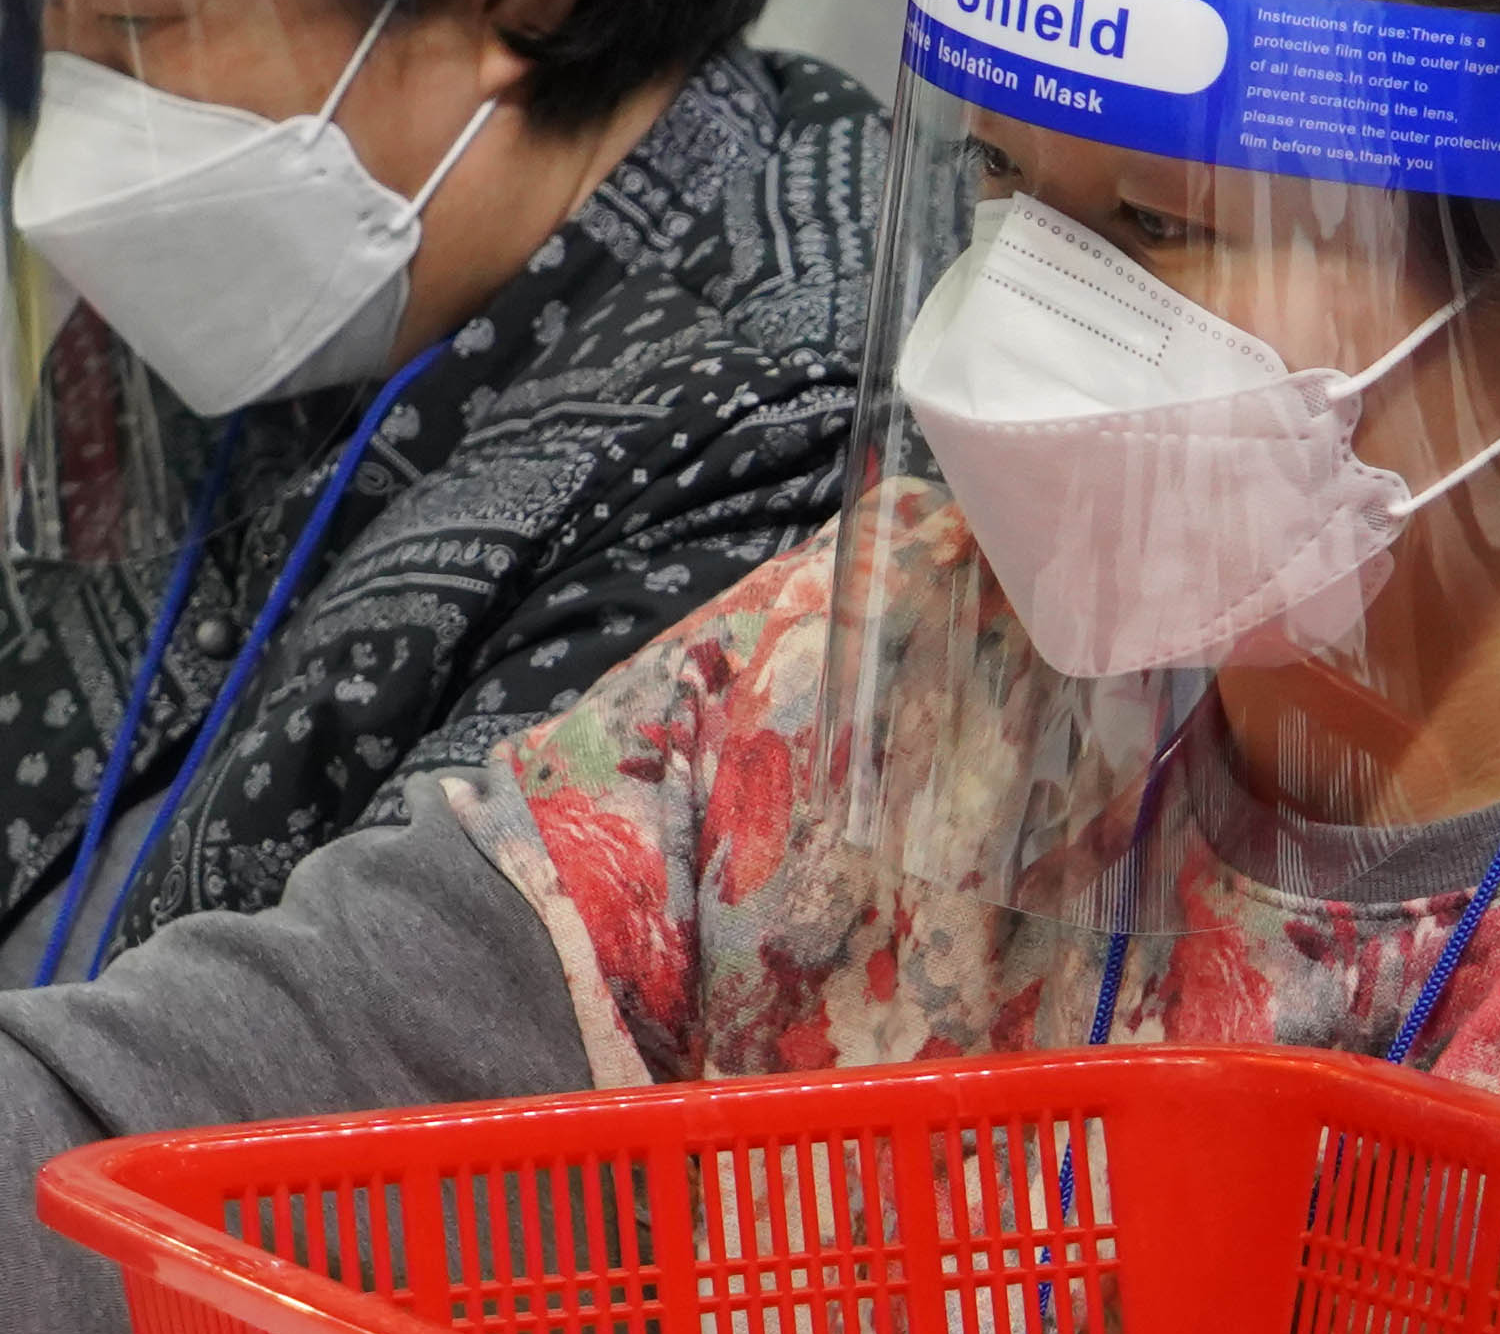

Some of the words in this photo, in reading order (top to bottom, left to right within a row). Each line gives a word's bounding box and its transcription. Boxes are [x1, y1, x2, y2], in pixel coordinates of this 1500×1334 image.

[1257, 8, 1348, 33] Instructions
[1353, 20, 1374, 35] for
[1460, 33, 1472, 47] is
[1476, 37, 1486, 48] a
[1253, 35, 1330, 55] protective
[1335, 44, 1362, 60] film
[1367, 50, 1387, 63] on
[1392, 51, 1416, 66] the
[1420, 56, 1460, 71] outer
[1464, 58, 1500, 76] layer
[938, 36, 1019, 91] Isolation
[1034, 74, 1104, 115] Mask
[1250, 59, 1267, 72] of
[1270, 62, 1289, 75] all
[1368, 75, 1410, 91] order
[1414, 79, 1429, 93] to
[1246, 85, 1306, 104] prevent
[1309, 94, 1389, 116] scratching
[1394, 102, 1418, 117] the
[1423, 106, 1459, 124] lens,
[1242, 109, 1295, 127] please
[1299, 118, 1357, 136] remove
[1361, 123, 1386, 139] the
[1390, 130, 1430, 145] outer
[1239, 132, 1267, 148] film
[1271, 136, 1322, 156] before
[1406, 156, 1434, 171] you
